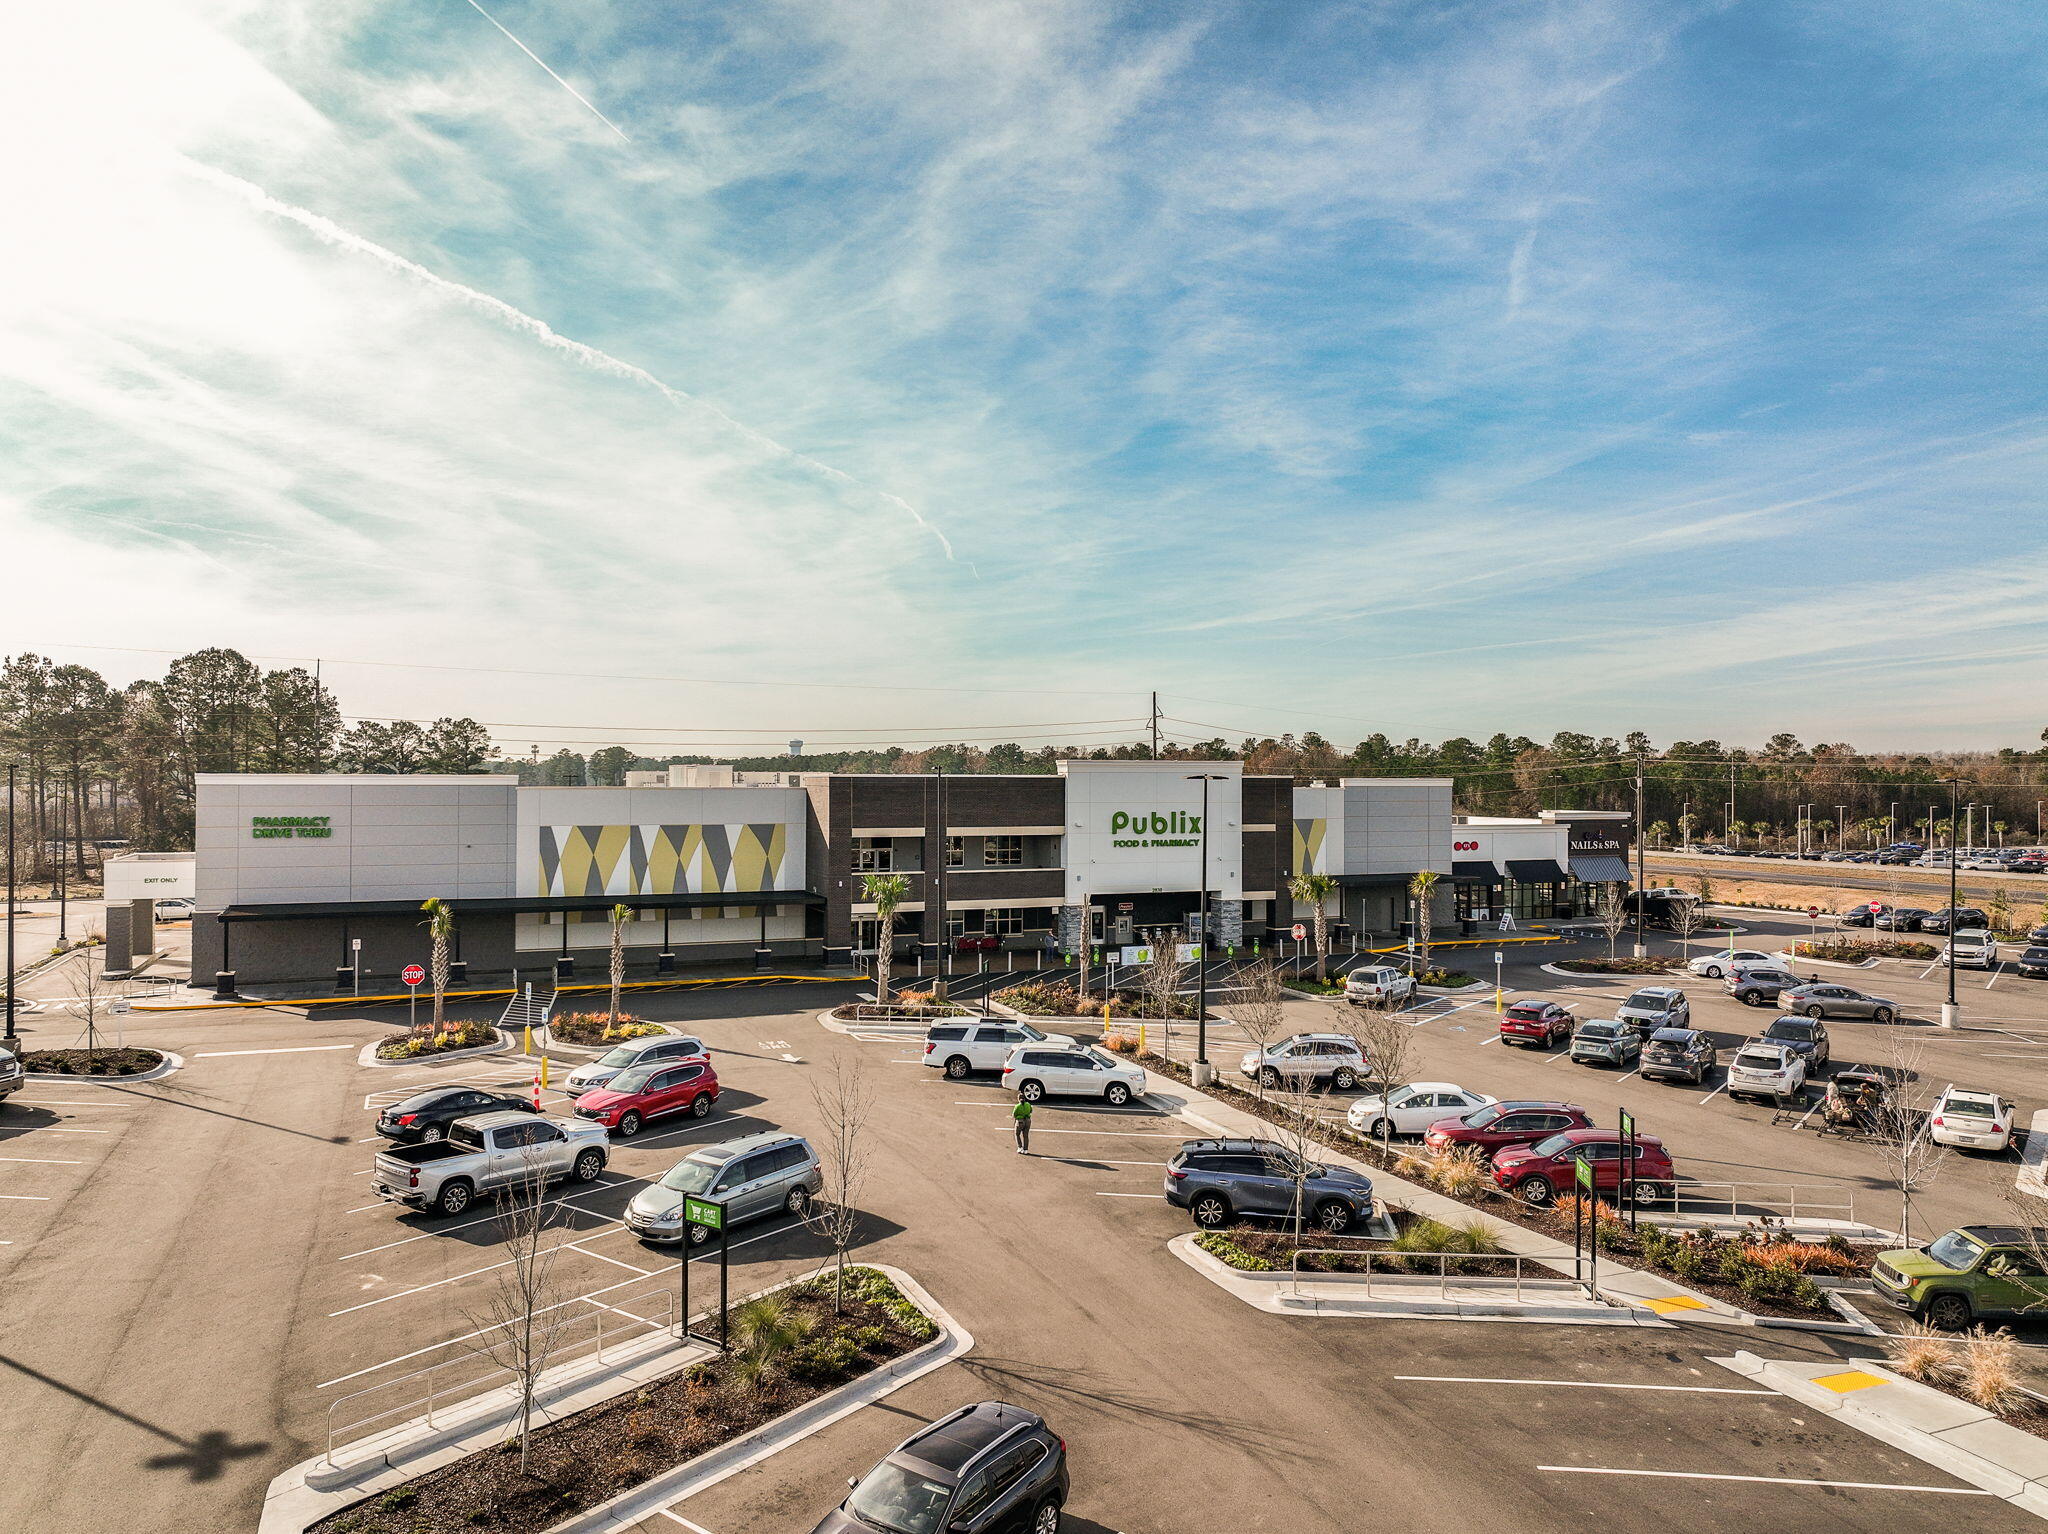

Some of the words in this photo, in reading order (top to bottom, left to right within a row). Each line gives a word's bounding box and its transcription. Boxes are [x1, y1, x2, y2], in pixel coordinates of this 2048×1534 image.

[253, 816, 330, 827] PHARMACY
[1112, 811, 1202, 834] Publix
[253, 828, 292, 838] DRIVE
[296, 828, 331, 838] THRU
[1113, 840, 1140, 848] FOOD
[1142, 840, 1149, 848] &
[1151, 839, 1200, 847] PHARMACY
[1570, 840, 1598, 850] NAILS
[1598, 842, 1604, 850] &
[1604, 840, 1620, 849] SPA
[404, 970, 424, 980] STOP
